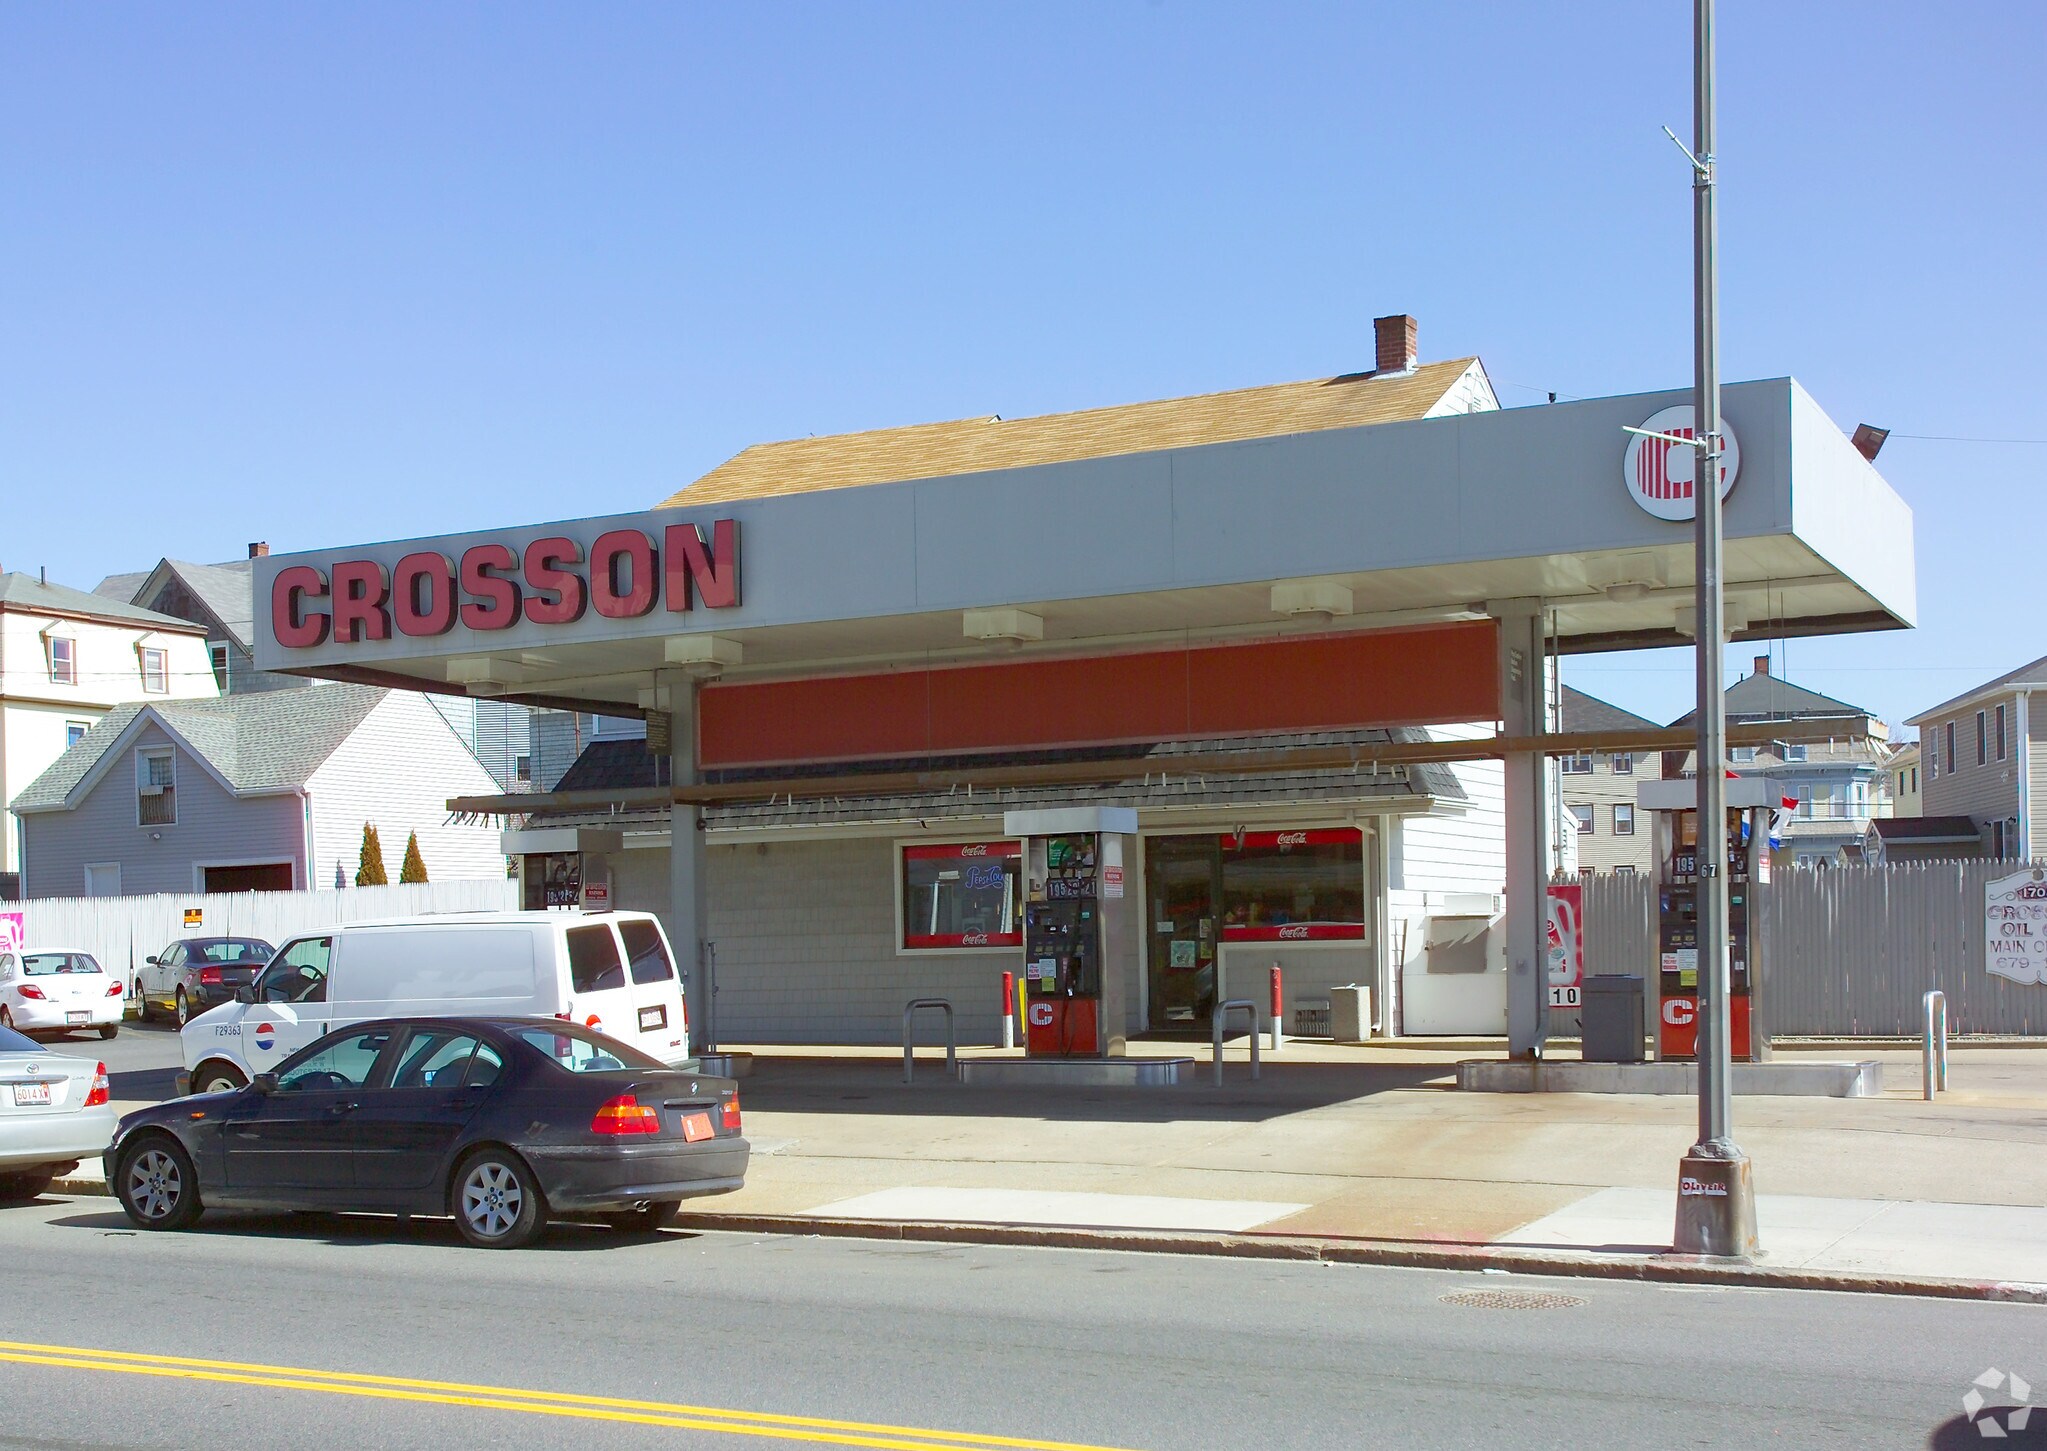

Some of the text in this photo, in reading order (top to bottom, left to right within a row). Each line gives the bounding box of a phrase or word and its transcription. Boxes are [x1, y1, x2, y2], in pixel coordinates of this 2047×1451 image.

[272, 518, 743, 649] CROSSON
[1277, 832, 1307, 844] Coca-Cola
[961, 845, 987, 857] Coca-Cola
[2023, 888, 2047, 898] 170
[1062, 924, 1068, 934] 4
[1279, 927, 1308, 938] Coca-Cola
[2000, 922, 2033, 937] OIL
[962, 934, 988, 945] Coca-Cola
[1990, 940, 2025, 953] MAIN
[1553, 988, 1577, 1004] 10
[1029, 1003, 1053, 1026] C
[1663, 999, 1693, 1025] C
[215, 1025, 242, 1036] F29363
[17, 1087, 37, 1100] 6014
